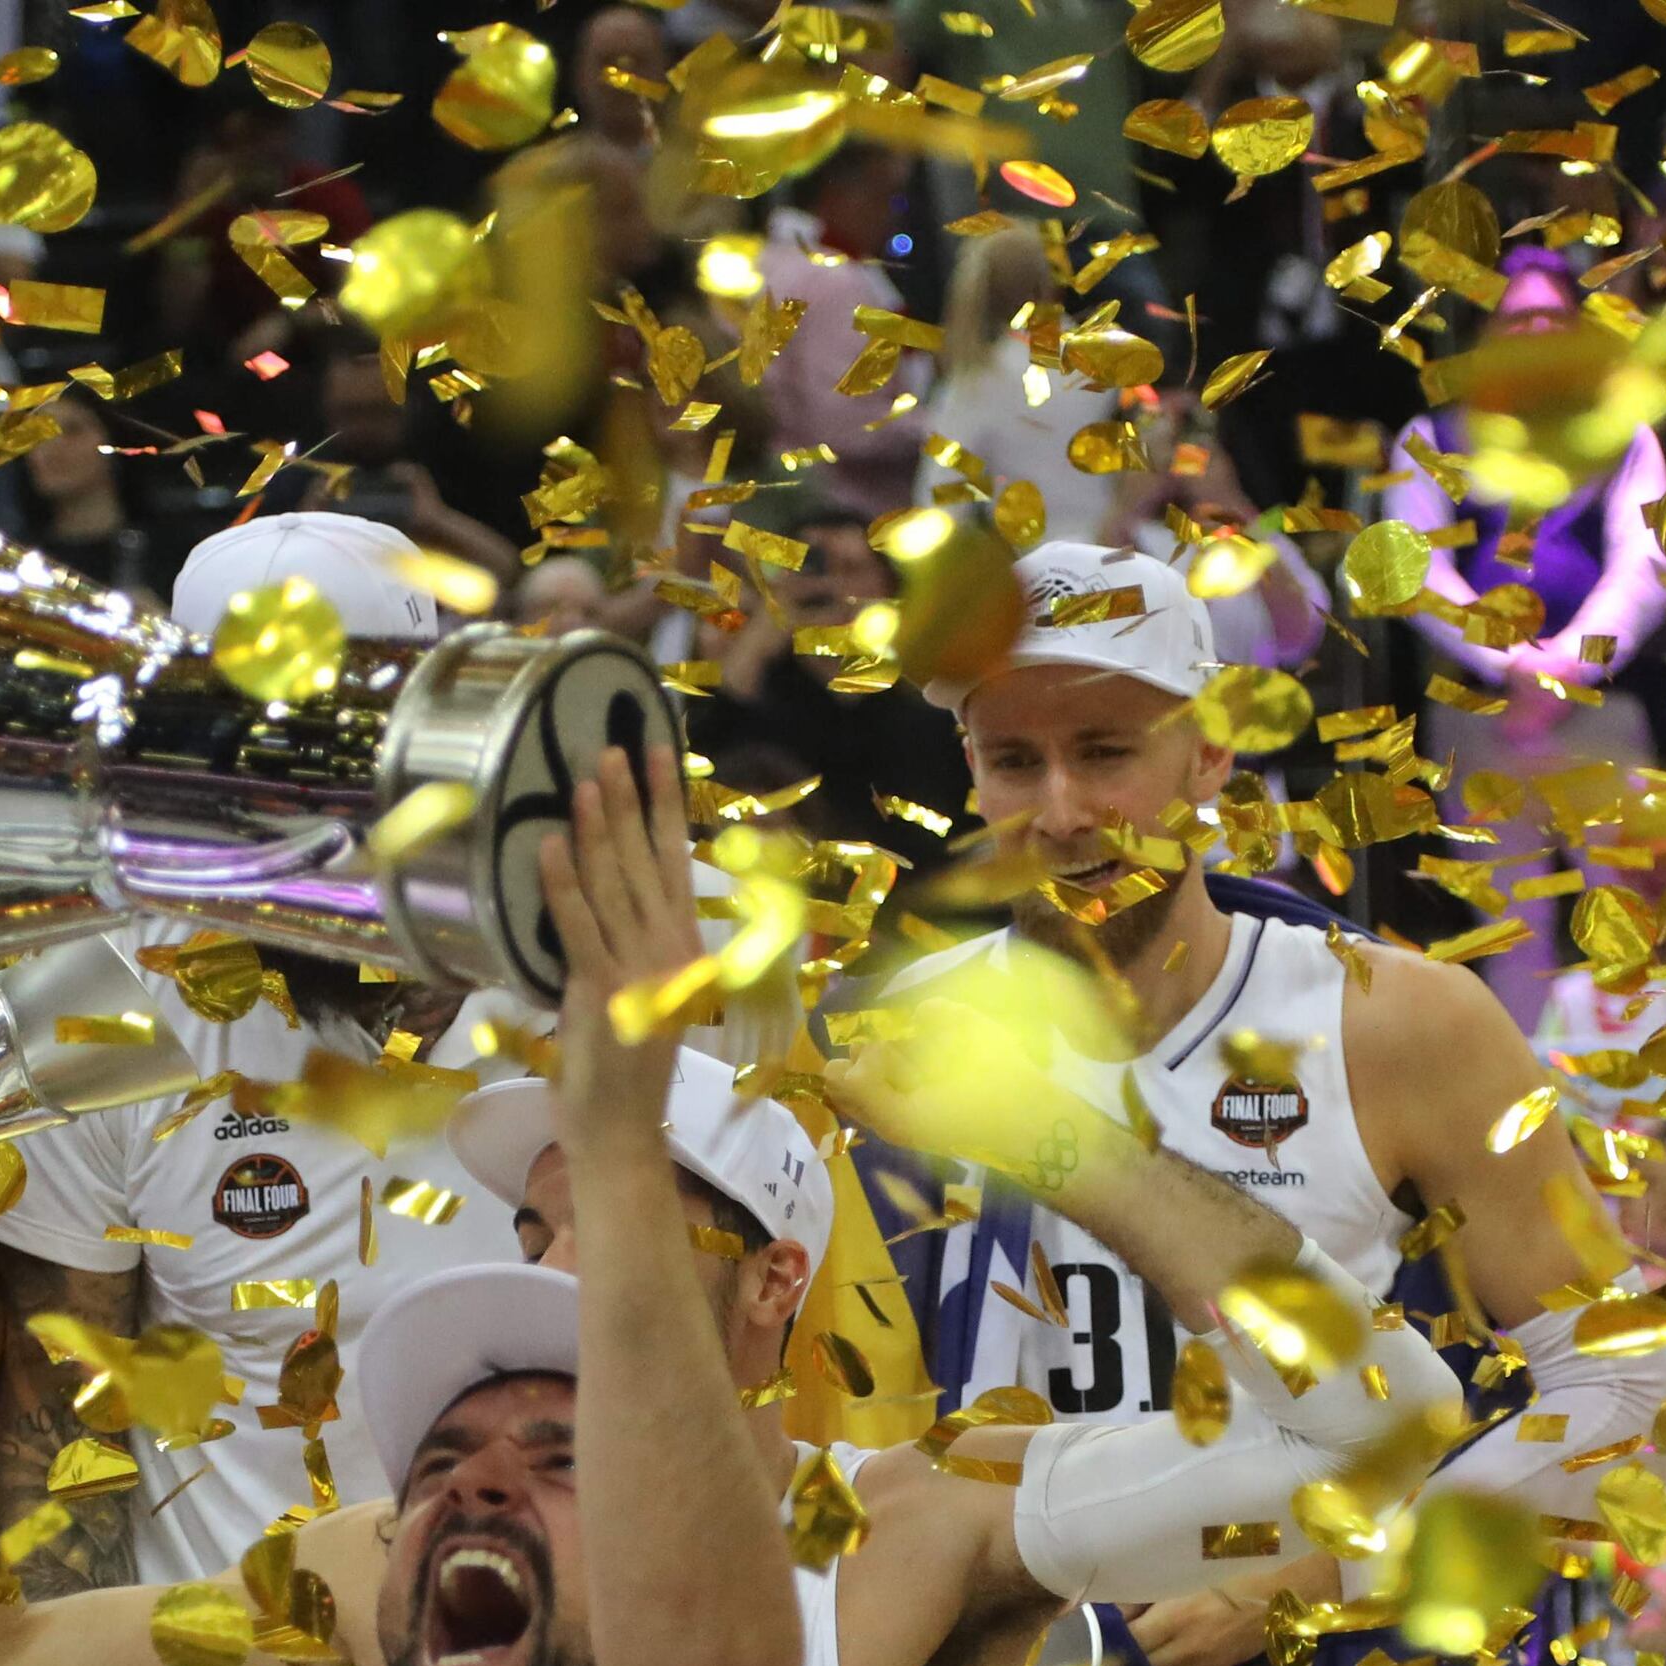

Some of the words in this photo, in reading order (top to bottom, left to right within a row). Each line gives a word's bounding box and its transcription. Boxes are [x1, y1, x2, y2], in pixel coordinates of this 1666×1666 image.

[1222, 1094, 1262, 1121] FINAL
[1263, 1093, 1299, 1119] FOUR
[214, 1117, 290, 1140] adidas
[223, 1187, 263, 1213] FINAL
[264, 1183, 299, 1210] FOUR
